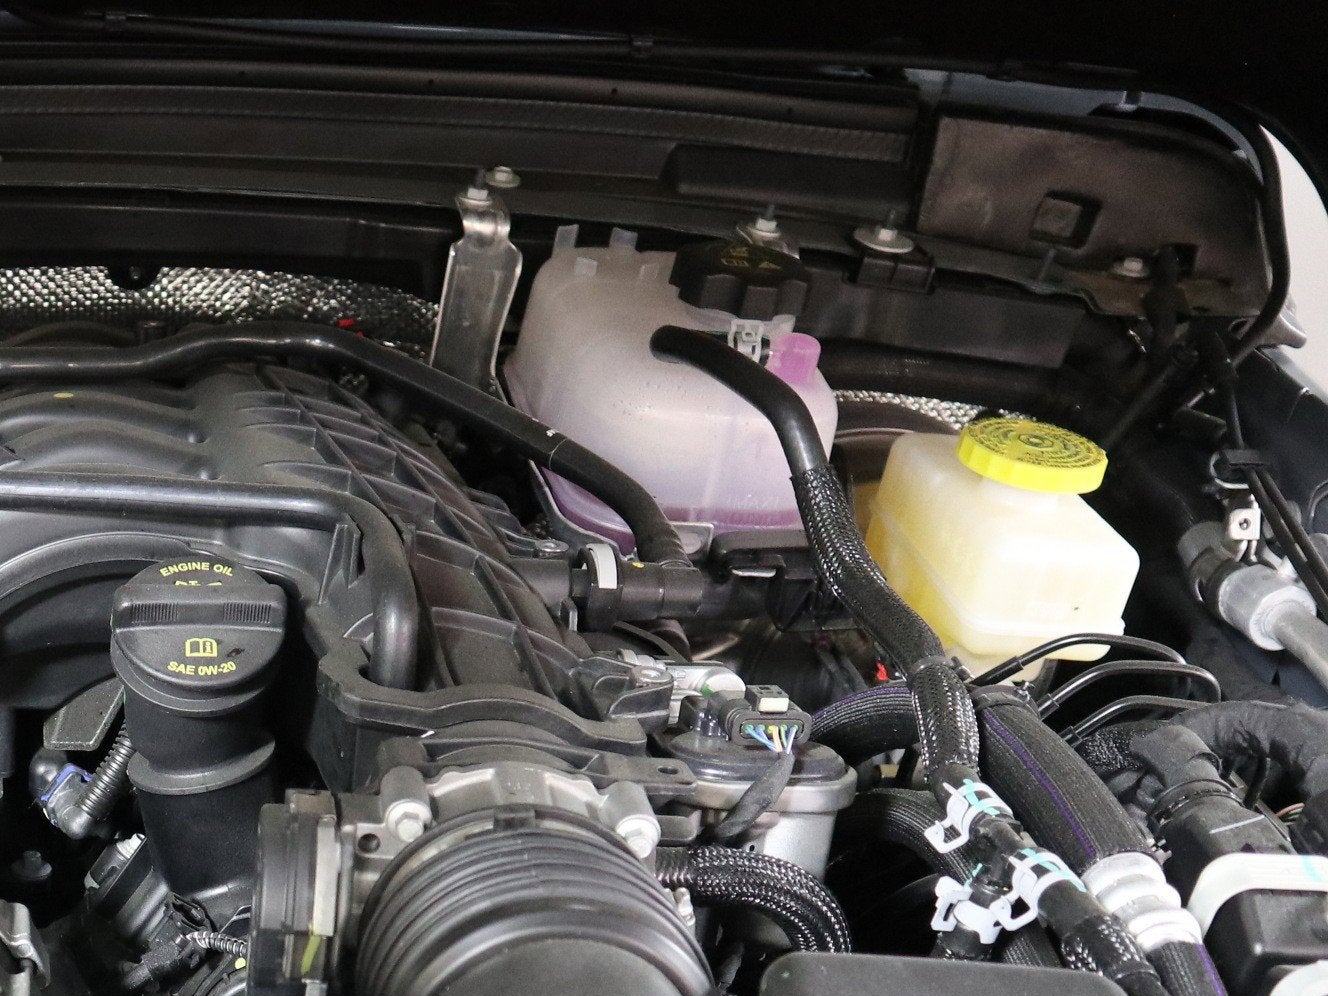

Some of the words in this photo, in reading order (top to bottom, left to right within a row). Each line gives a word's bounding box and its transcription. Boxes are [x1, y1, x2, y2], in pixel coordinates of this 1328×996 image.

[159, 561, 211, 577] ENGINE
[213, 564, 233, 577] OIL
[167, 661, 196, 676] SAE
[197, 661, 237, 676] 0W-20
